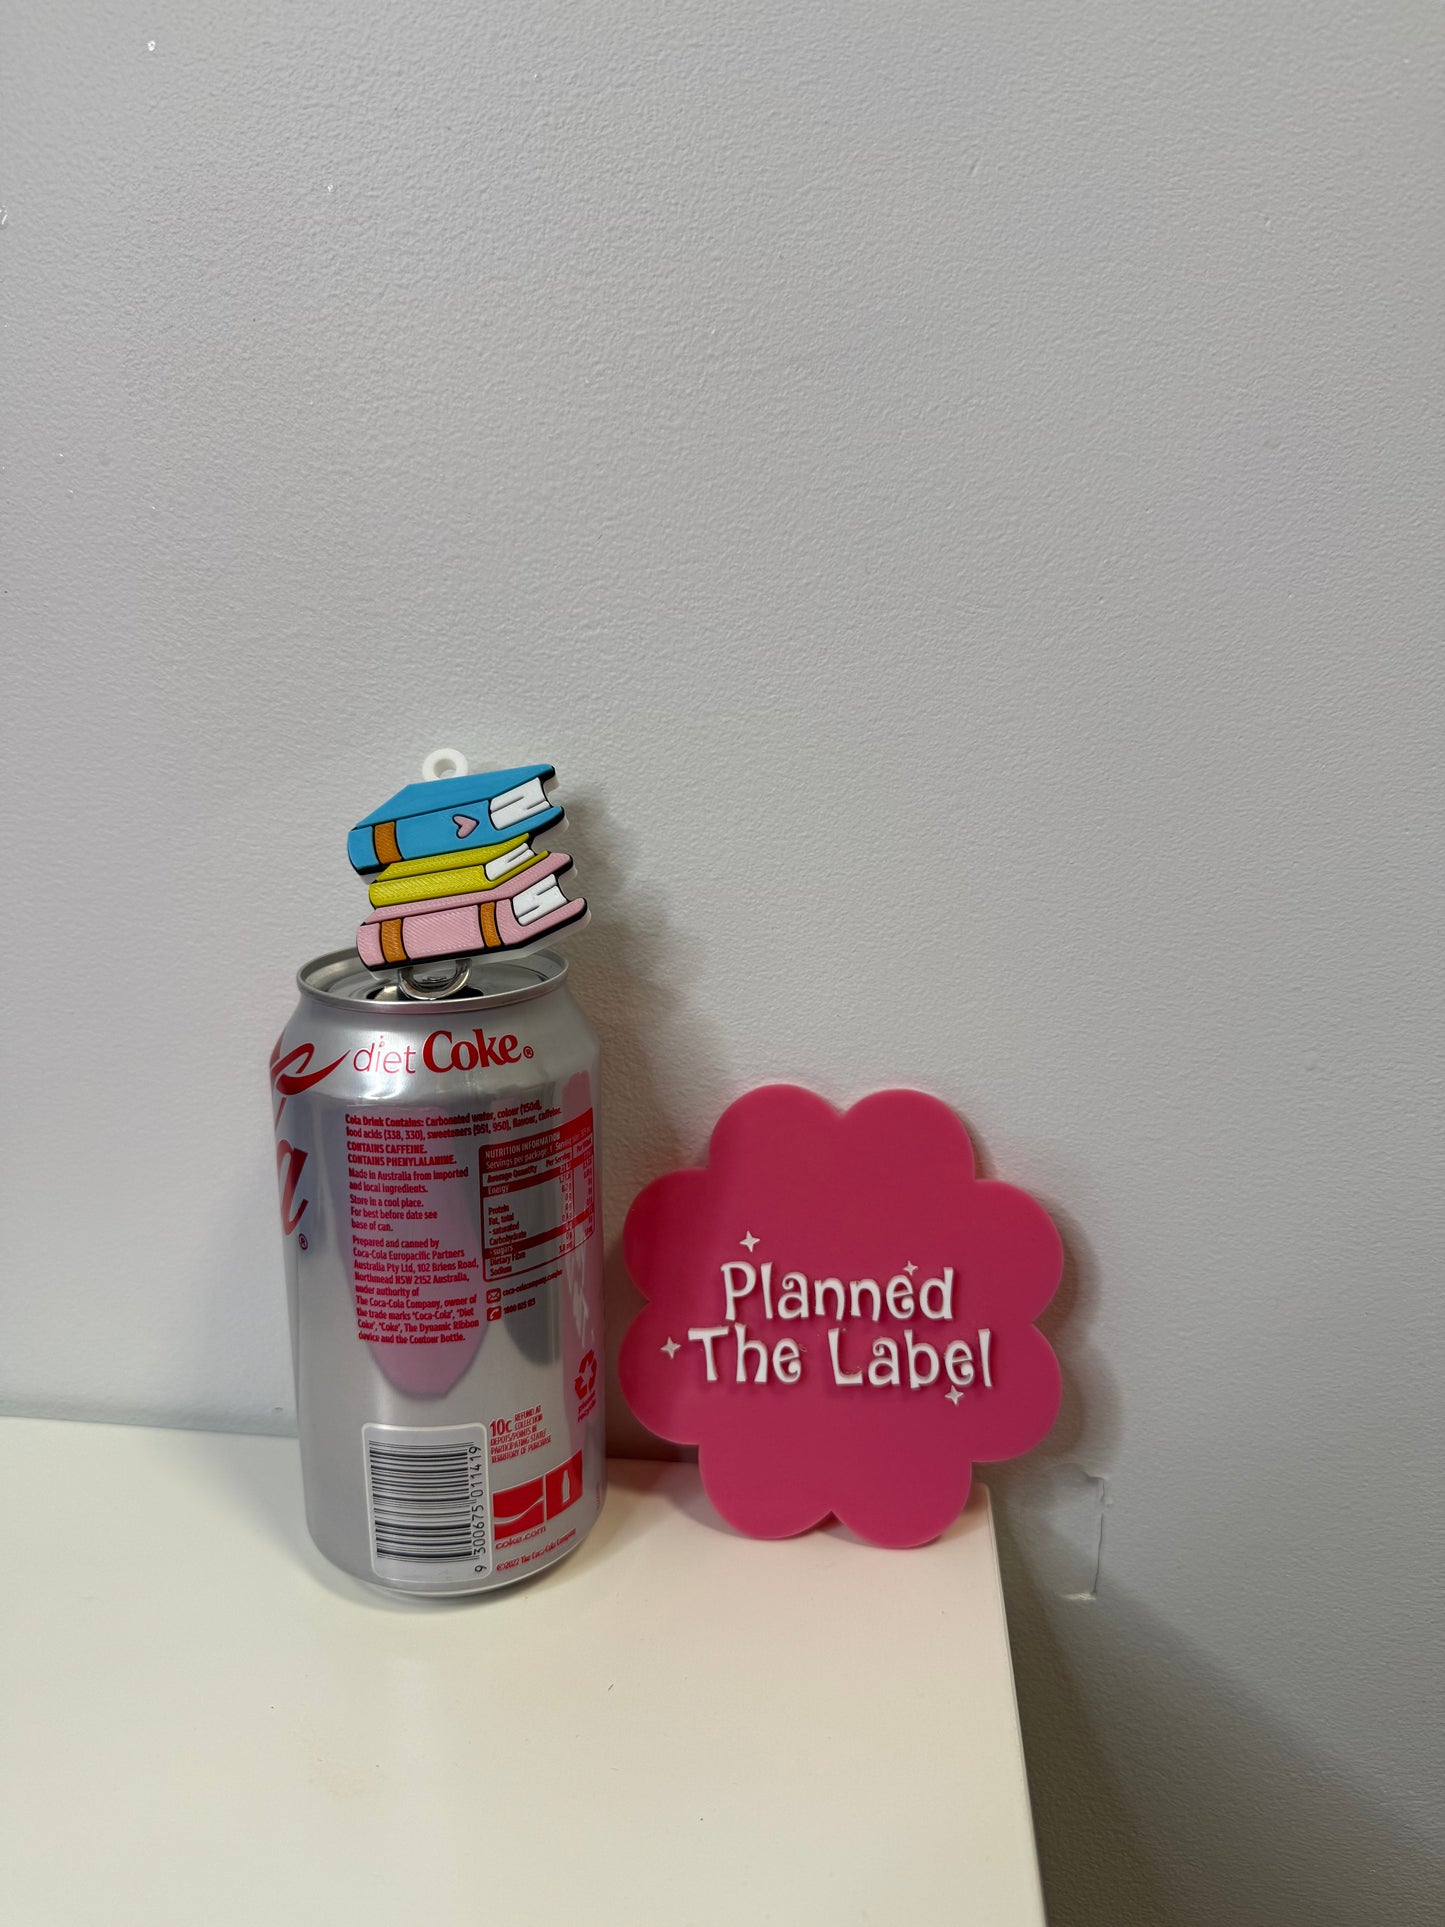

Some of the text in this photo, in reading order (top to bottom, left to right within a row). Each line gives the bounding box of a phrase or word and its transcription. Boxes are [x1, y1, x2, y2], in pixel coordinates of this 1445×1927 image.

[353, 1036, 416, 1074] diet
[345, 1114, 361, 1125] Cola
[363, 1116, 383, 1126] Drink
[386, 1117, 423, 1127] Contains:
[426, 1113, 470, 1126] Carbonated
[472, 1113, 496, 1123] water,
[497, 1107, 518, 1118] colour
[346, 1126, 361, 1137] food
[364, 1130, 382, 1139] acids
[384, 1130, 404, 1140] (338,
[406, 1130, 425, 1140] 330),
[427, 1126, 472, 1139] sweeteners
[473, 1124, 491, 1136] (951,
[493, 1120, 511, 1132] 950),
[347, 1141, 427, 1154] CONTAINS CAFFEINE.
[485, 1144, 520, 1159] NUTRITION
[522, 1132, 560, 1148] INFORMATION
[348, 1154, 457, 1166] CONTAINS PHENYLALANINE.
[486, 1158, 513, 1169] Servings
[514, 1155, 524, 1166] per
[349, 1166, 469, 1181] Made in Australia from imported
[349, 1181, 428, 1195] and local ingredients.
[488, 1184, 509, 1195] Energy
[350, 1194, 368, 1205] Store
[370, 1197, 376, 1206] in
[384, 1198, 399, 1207] cool
[401, 1198, 424, 1208] place.
[351, 1207, 438, 1219] For best before date see
[488, 1204, 509, 1215] Protein
[352, 1218, 393, 1231] base of can.
[489, 1213, 514, 1225] Fat, total
[493, 1221, 519, 1235] saturated
[352, 1235, 440, 1249] Prepared and canned by
[489, 1231, 527, 1246] Carbohydrate
[353, 1247, 464, 1261] Coca-Cola Europacific Partners
[493, 1245, 513, 1257] sugars
[354, 1258, 479, 1274] Australia Pty Ltd, 102 Briens Road,
[490, 1265, 512, 1276] Sodium
[355, 1272, 469, 1284] Northmead NSW 2152 Australia,
[355, 1285, 420, 1298] under authority of
[721, 1261, 954, 1322] Planned
[356, 1294, 477, 1310] The Coca-Cola Company, owner of
[357, 1308, 367, 1317] the
[369, 1309, 387, 1319] trade
[389, 1311, 410, 1320] marks
[404, 1323, 417, 1332] The
[419, 1322, 451, 1333] Dynamic
[453, 1319, 479, 1330] Ribbon
[359, 1331, 465, 1344] device and the Contour Bottle.
[688, 1322, 993, 1390] The Label
[490, 1419, 512, 1437] 10c
[468, 1446, 483, 1498] 011419
[471, 1504, 486, 1555] 300675
[496, 1526, 546, 1550] coke.com
